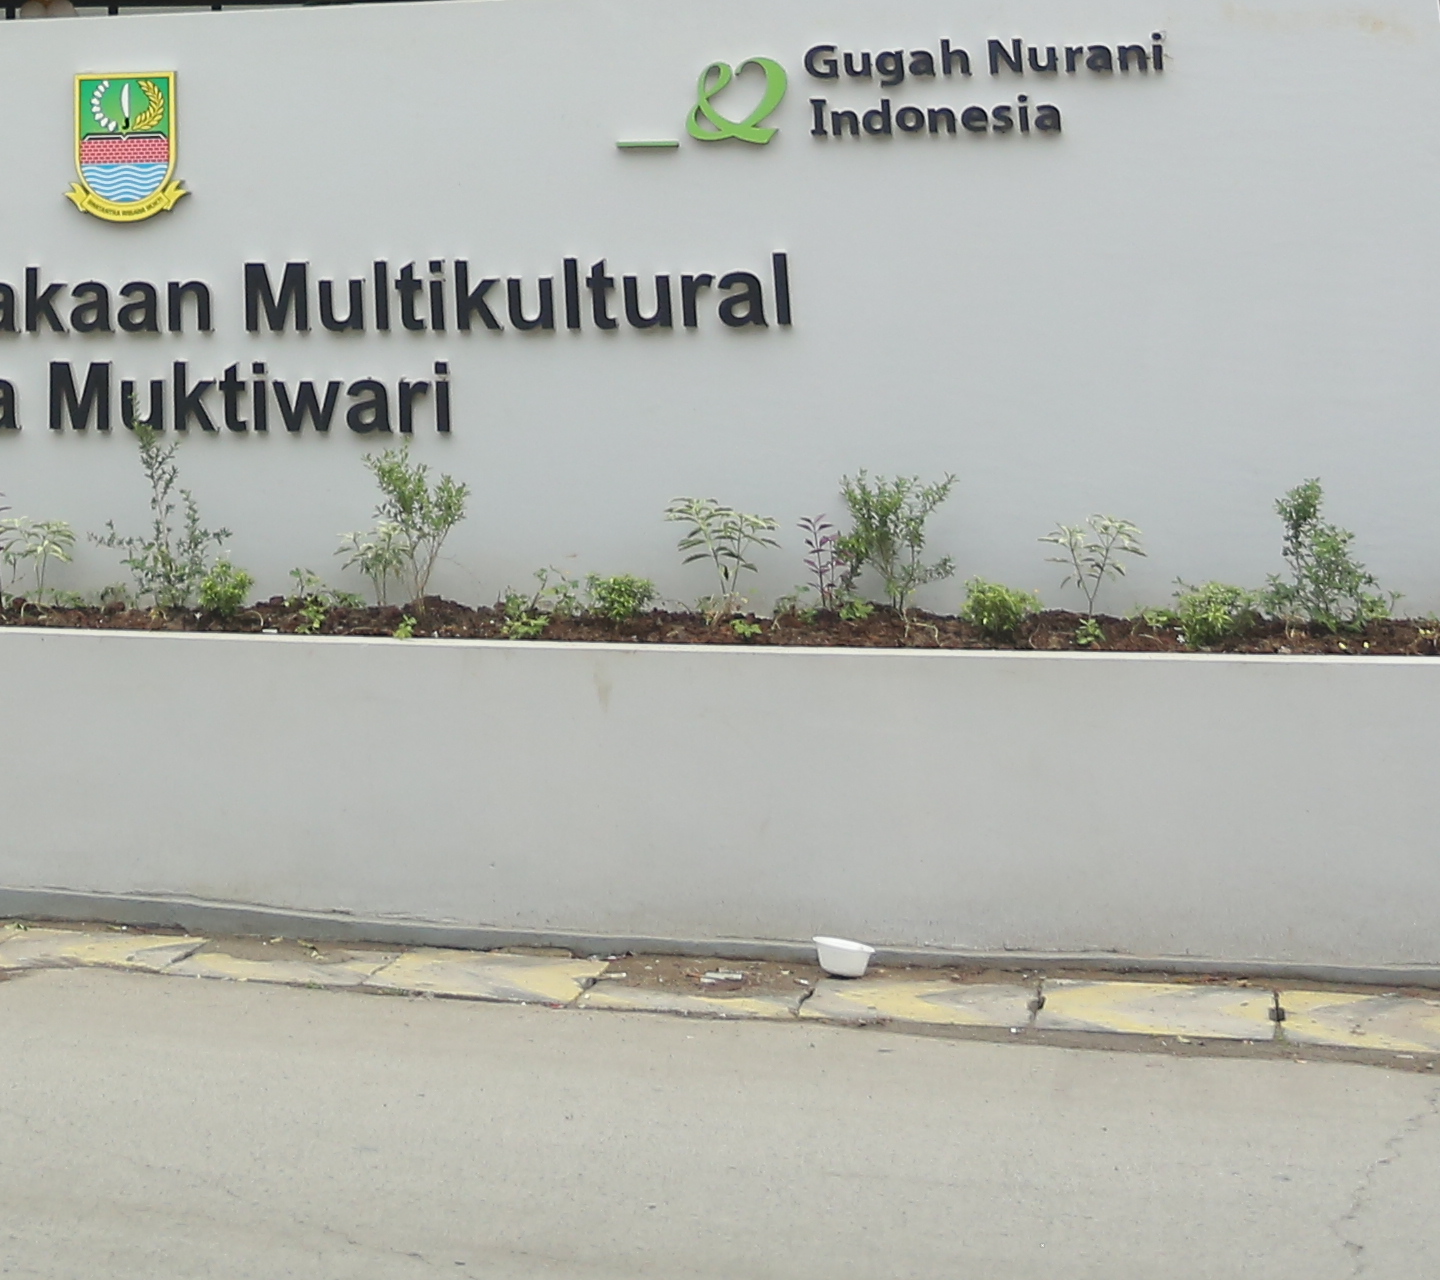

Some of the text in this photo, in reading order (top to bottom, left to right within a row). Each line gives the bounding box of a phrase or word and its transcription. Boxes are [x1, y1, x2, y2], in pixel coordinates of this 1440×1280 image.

[803, 32, 1165, 87] Gugah Nurani
[809, 94, 1063, 137] Indonesia
[243, 251, 794, 334] Multikultural
[48, 360, 453, 435] Muktiwari
